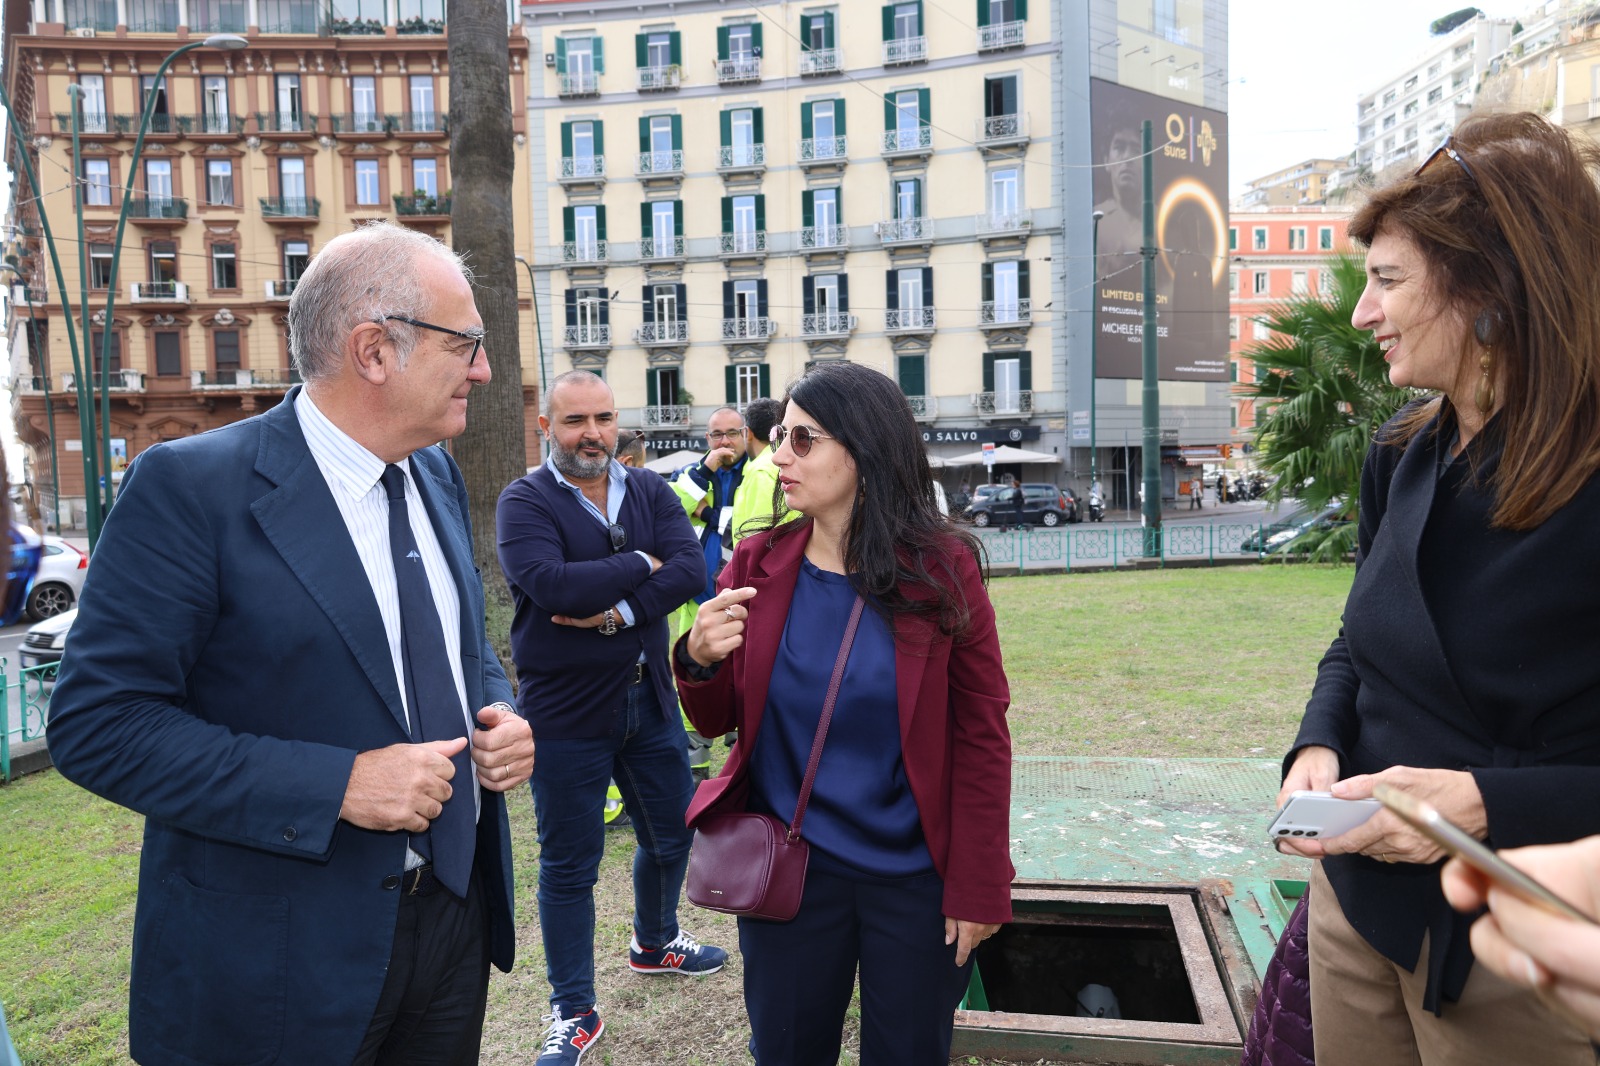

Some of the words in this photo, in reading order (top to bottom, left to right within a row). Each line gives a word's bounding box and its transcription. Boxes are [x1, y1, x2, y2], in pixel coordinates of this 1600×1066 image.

[1102, 289, 1134, 301] LIMITED
[1102, 323, 1134, 335] MICHELE
[937, 432, 978, 441] SALVO
[645, 440, 700, 449] PIZZERIA
